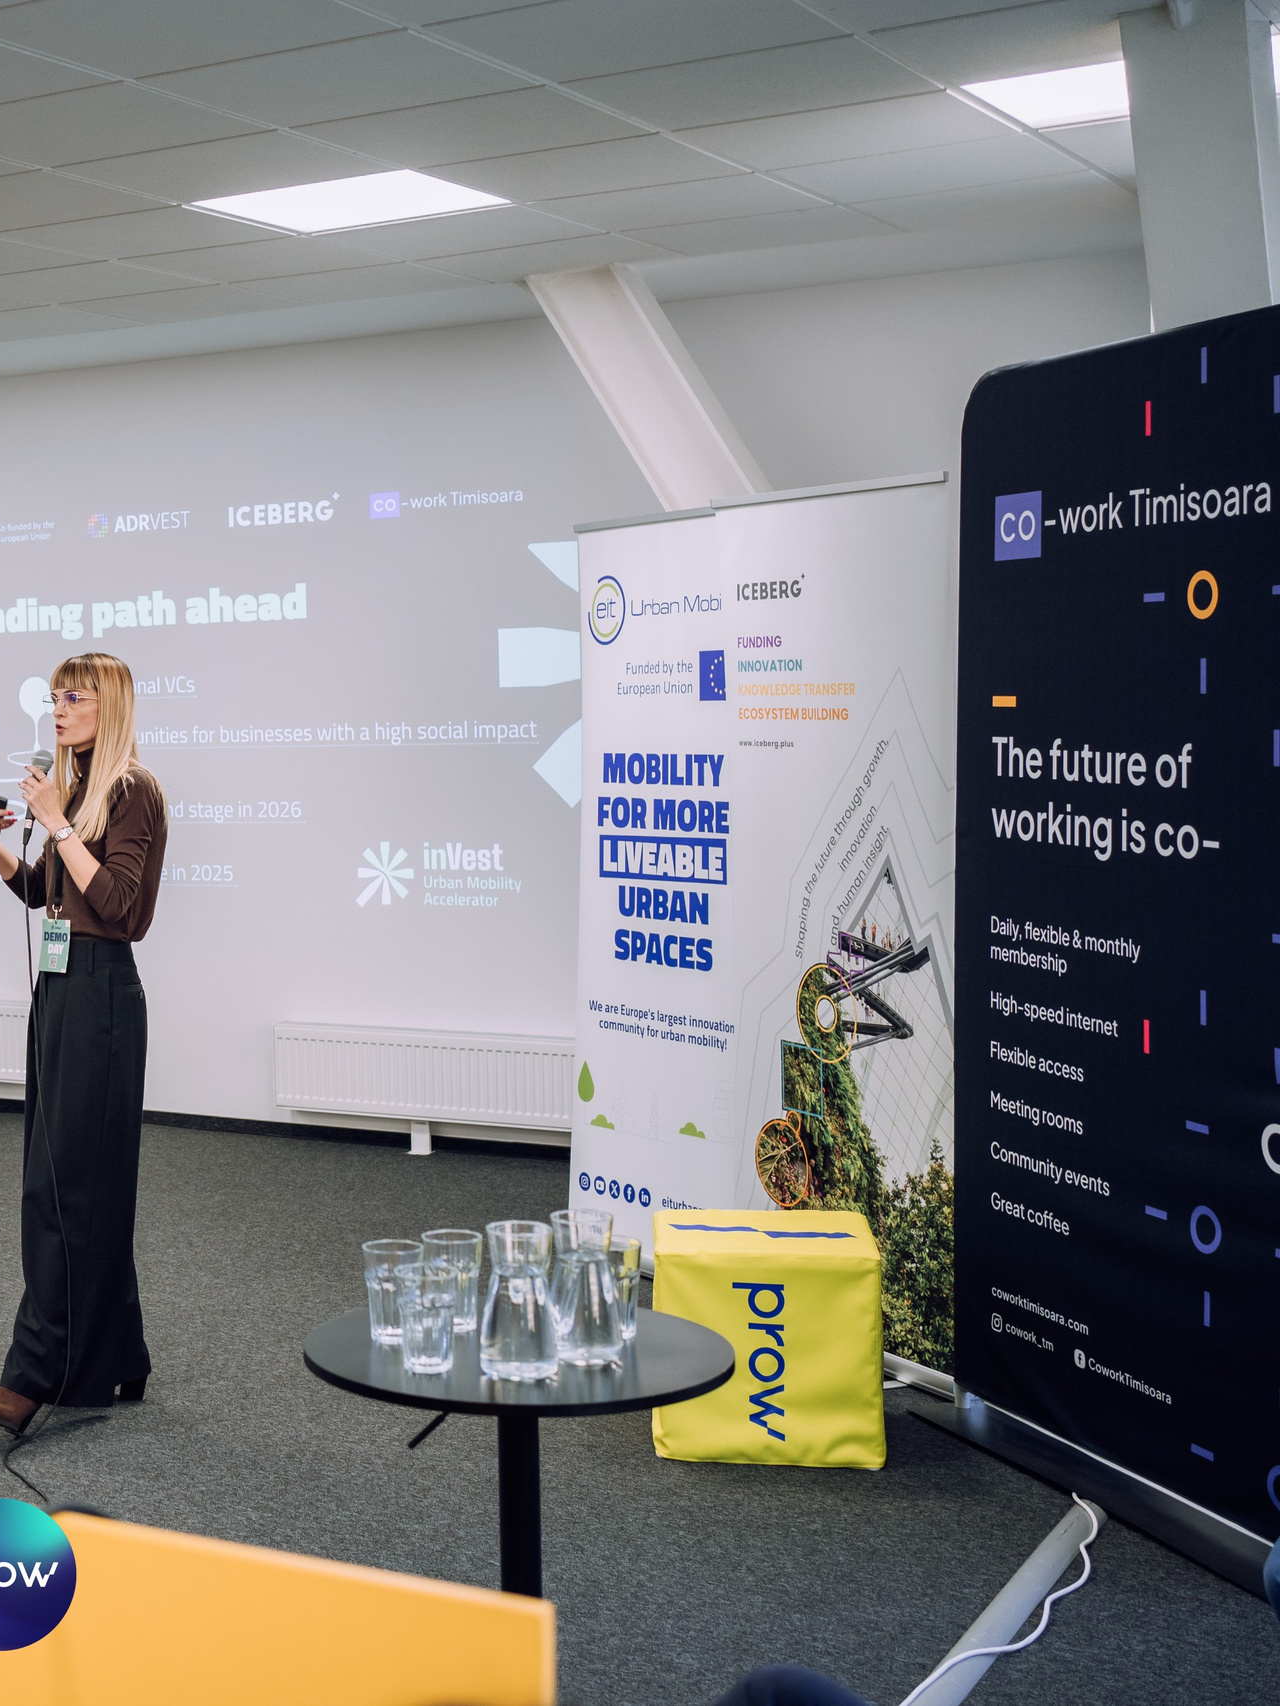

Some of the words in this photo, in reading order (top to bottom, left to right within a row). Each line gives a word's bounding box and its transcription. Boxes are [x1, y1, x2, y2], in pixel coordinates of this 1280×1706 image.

[450, 489, 524, 507] Timisoara
[1129, 482, 1272, 527] Timisoara
[30, 532, 51, 541] Union
[33, 522, 41, 530] by
[42, 520, 54, 529] the
[114, 510, 190, 533] ADRVEST
[92, 590, 177, 638] path
[185, 582, 307, 624] ahead
[596, 601, 616, 619] eit
[630, 598, 680, 616] Urban
[683, 593, 722, 613] Mobi
[737, 635, 782, 649] FUNDING
[626, 661, 660, 675] Funded
[663, 660, 674, 676] by
[676, 659, 693, 673] the
[737, 659, 803, 672] INNOVATION
[164, 675, 195, 693] VCs
[617, 682, 661, 697] European
[663, 681, 693, 694] Union
[738, 683, 802, 696] KNOWLEDGE
[803, 683, 856, 696] TRANSFER
[738, 708, 799, 720] ECOSYSTEM
[801, 708, 849, 721] BUILDING
[192, 725, 216, 743] for
[219, 725, 312, 743] businesses
[317, 723, 355, 741] with
[360, 727, 370, 741] a
[374, 721, 412, 745] high
[417, 720, 468, 740] social
[474, 720, 538, 744] impact
[739, 738, 795, 749] www.iceberg.plus
[603, 753, 725, 787] MOBILITY
[992, 736, 1043, 779] The
[1049, 738, 1147, 786] future
[1155, 742, 1193, 788] of
[188, 802, 234, 824] stage
[238, 801, 252, 818] in
[257, 801, 302, 818] 2026
[597, 796, 647, 829] FOR
[653, 799, 730, 834] MORE
[837, 805, 877, 873] innovation
[991, 801, 1113, 861] working
[1121, 808, 1146, 854] is
[1154, 822, 1220, 859] co-
[423, 842, 504, 871] inVest
[603, 839, 724, 881] LIVEABLE
[795, 896, 811, 958] shaping
[804, 872, 818, 895] the
[815, 836, 837, 874] future
[833, 785, 865, 835] through
[862, 739, 889, 788] growth,
[172, 864, 186, 881] in
[191, 865, 234, 882] 2025
[423, 876, 463, 889] Urban
[467, 876, 522, 894] Mobility
[830, 915, 840, 946] and
[837, 868, 866, 916] human
[864, 825, 889, 875] insight.
[424, 892, 499, 907] Accelerator
[618, 885, 709, 925] URBAN
[44, 931, 68, 943] DEMO
[48, 943, 64, 955] DAY
[614, 928, 713, 972] SPACES
[990, 915, 1022, 941] Daily,
[1024, 921, 1070, 947] flexible
[1072, 929, 1082, 949] &
[1085, 935, 1141, 964] monthly
[990, 945, 1067, 977] membership
[589, 999, 603, 1012] We
[604, 1003, 619, 1014] are
[621, 1004, 655, 1021] Europe's
[657, 1010, 687, 1027] largest
[689, 1015, 735, 1034] innovation
[990, 990, 1064, 1025] High-speed
[1066, 1008, 1118, 1037] internet
[599, 1018, 644, 1038] community
[646, 1025, 659, 1038] for
[661, 1029, 686, 1043] urban
[687, 1034, 727, 1052] mobility!
[990, 1040, 1036, 1069] Flexible
[1038, 1057, 1084, 1082] access
[990, 1090, 1040, 1126] Meeting
[1042, 1110, 1083, 1135] rooms
[990, 1141, 1063, 1184] Community
[1065, 1169, 1110, 1196] events
[990, 1192, 1025, 1220] Great
[1027, 1208, 1070, 1235] coffee
[991, 1286, 1089, 1336] coworktimisoara.com
[1005, 1323, 1054, 1352] cowork_tm
[732, 1282, 786, 1442] prow
[1088, 1357, 1172, 1405] CoworkTimisoara
